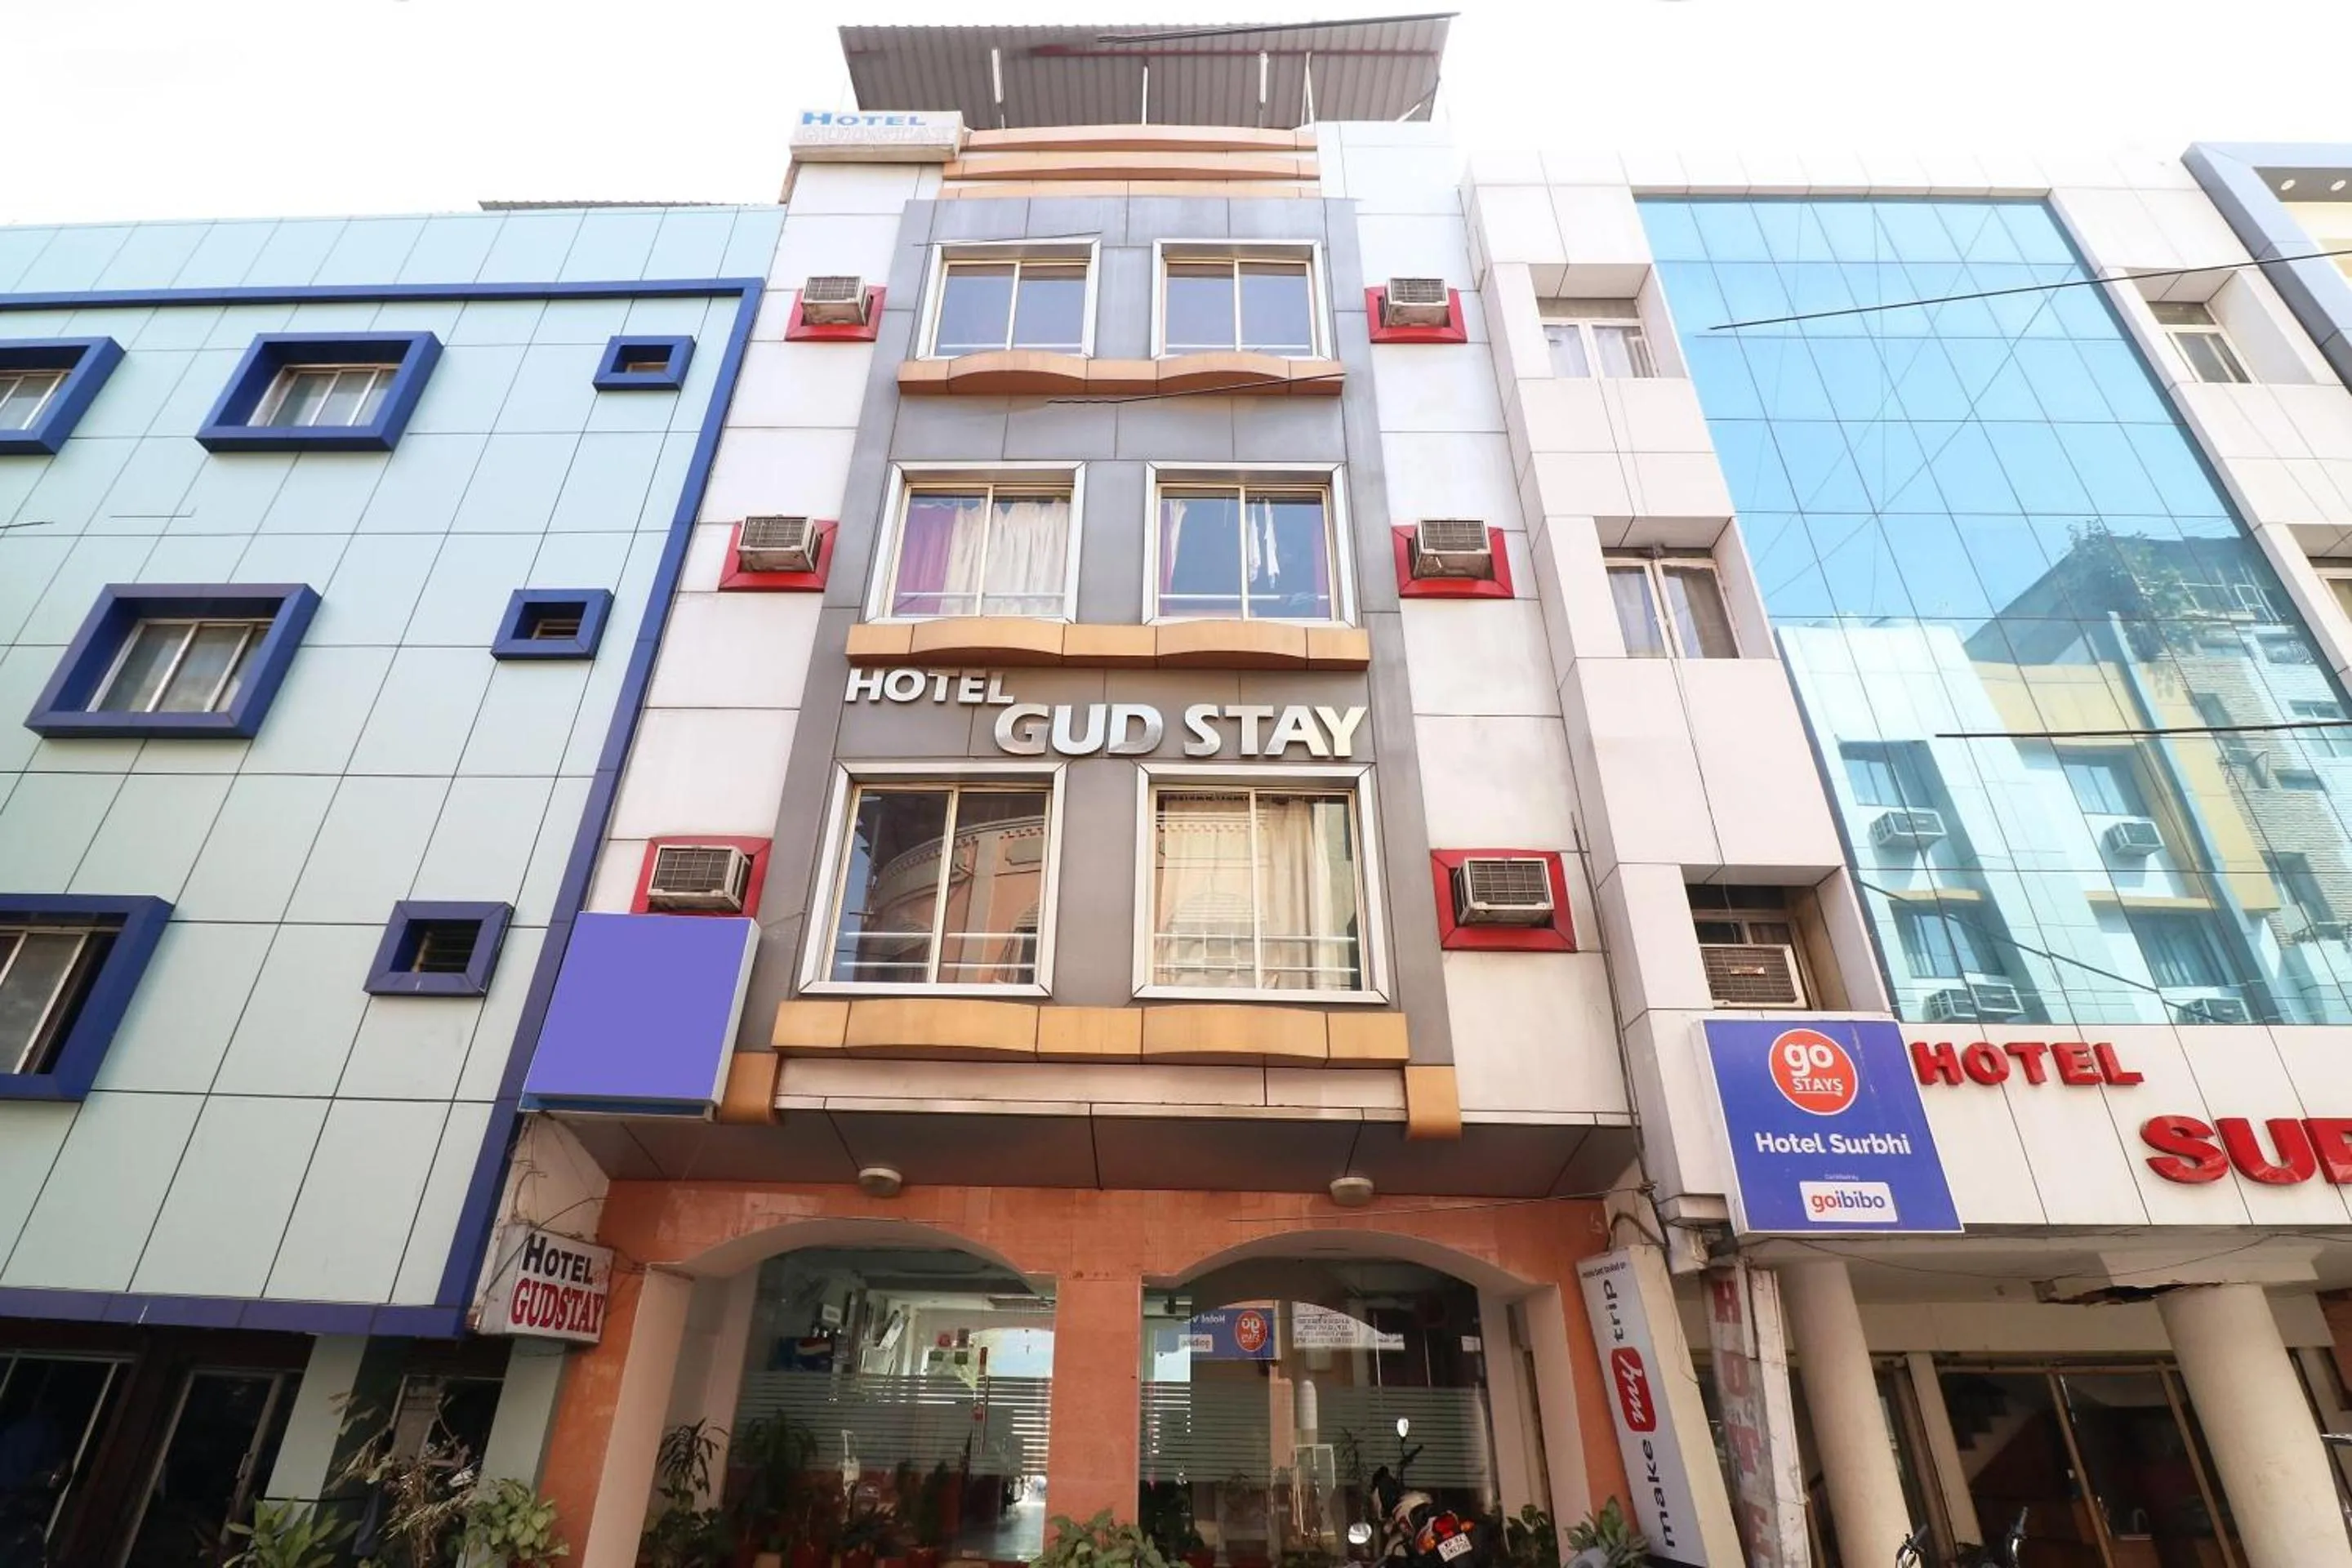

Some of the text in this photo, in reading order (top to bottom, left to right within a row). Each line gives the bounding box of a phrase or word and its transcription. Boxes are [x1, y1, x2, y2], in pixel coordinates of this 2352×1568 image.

[801, 113, 927, 126] HOTEL
[844, 668, 1014, 705] HOTEL
[994, 703, 1367, 758] GUD STAY
[1784, 1044, 1834, 1077] go
[1909, 1041, 2145, 1087] HOTEL
[1793, 1077, 1843, 1093] STAYS
[1754, 1131, 1912, 1156] Hotel Surbhi
[1811, 1190, 1886, 1213] goibibo
[522, 1233, 594, 1285] HOTEL
[510, 1277, 606, 1334] GUDSTAY
[1603, 1279, 1624, 1343] trip
[1618, 1354, 1646, 1424] my
[1642, 1438, 1676, 1548] make
